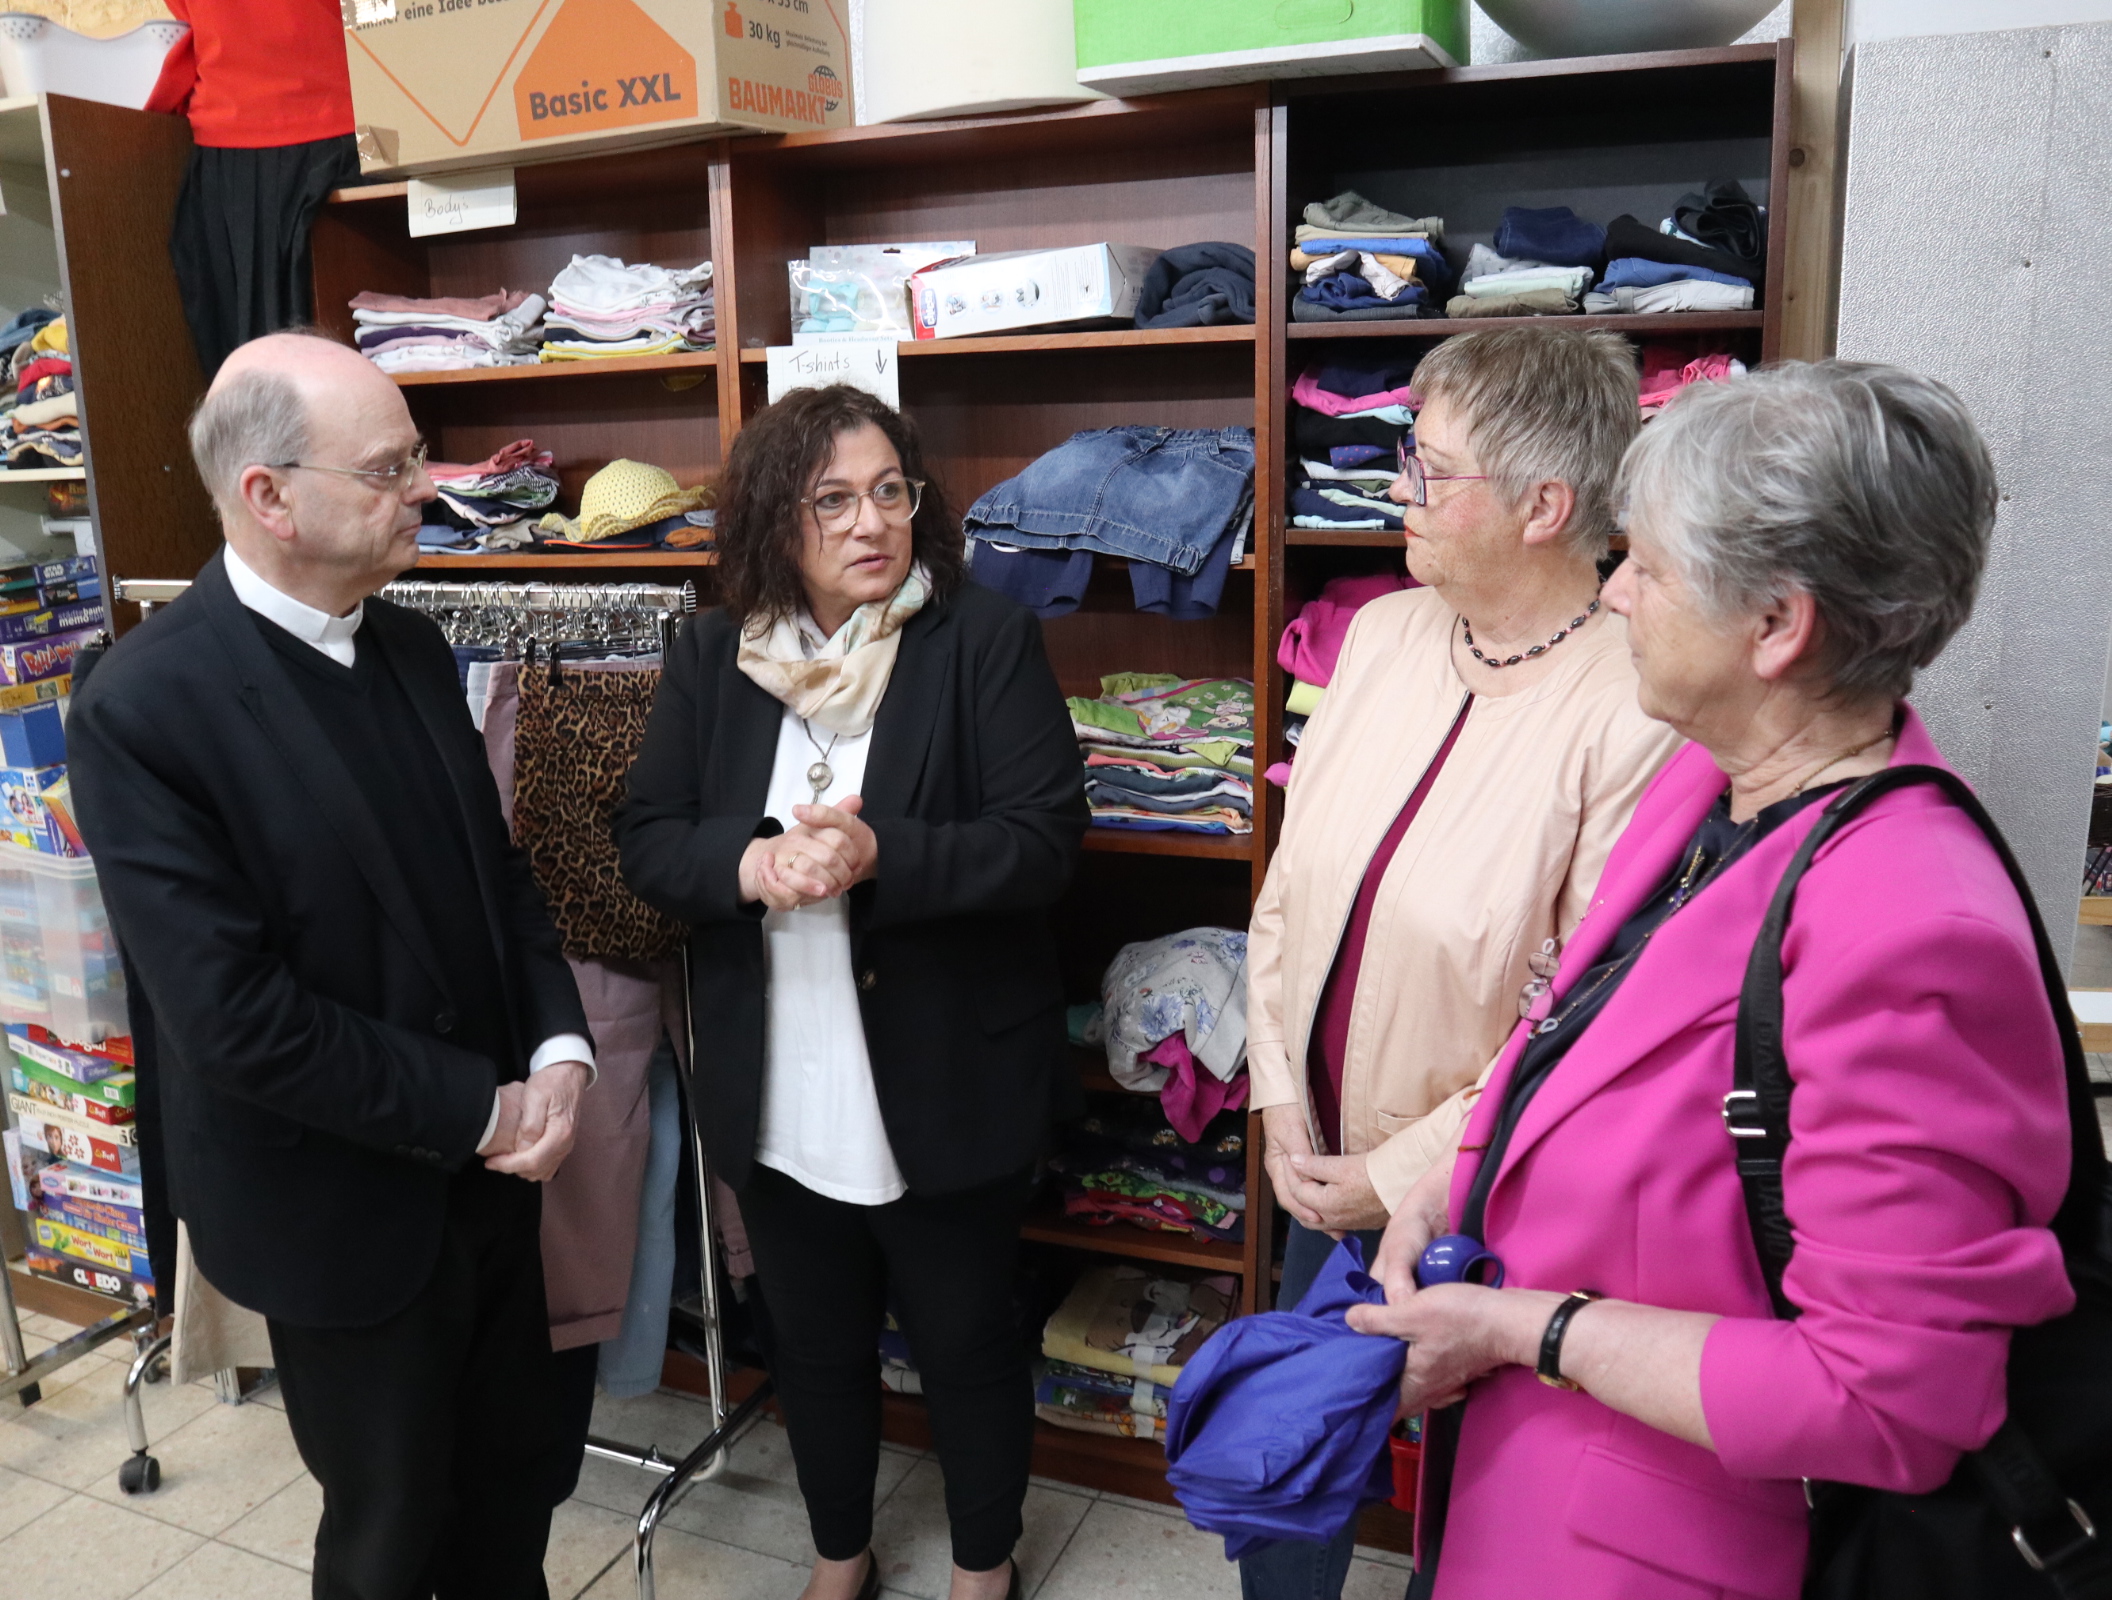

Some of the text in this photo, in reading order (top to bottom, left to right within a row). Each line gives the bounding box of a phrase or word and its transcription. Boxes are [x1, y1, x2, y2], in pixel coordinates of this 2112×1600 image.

[404, 0, 472, 20] eine Idee
[793, 0, 809, 14] cm
[748, 20, 781, 48] 30 kg
[529, 72, 682, 120] Basic XXL
[808, 73, 843, 99] GLOBUS
[728, 77, 826, 125] BAUMARKT
[10, 1097, 37, 1115] GIANT
[71, 1235, 92, 1248] Wort
[93, 1247, 114, 1260] Wort
[73, 1268, 121, 1292] CLUEDO
